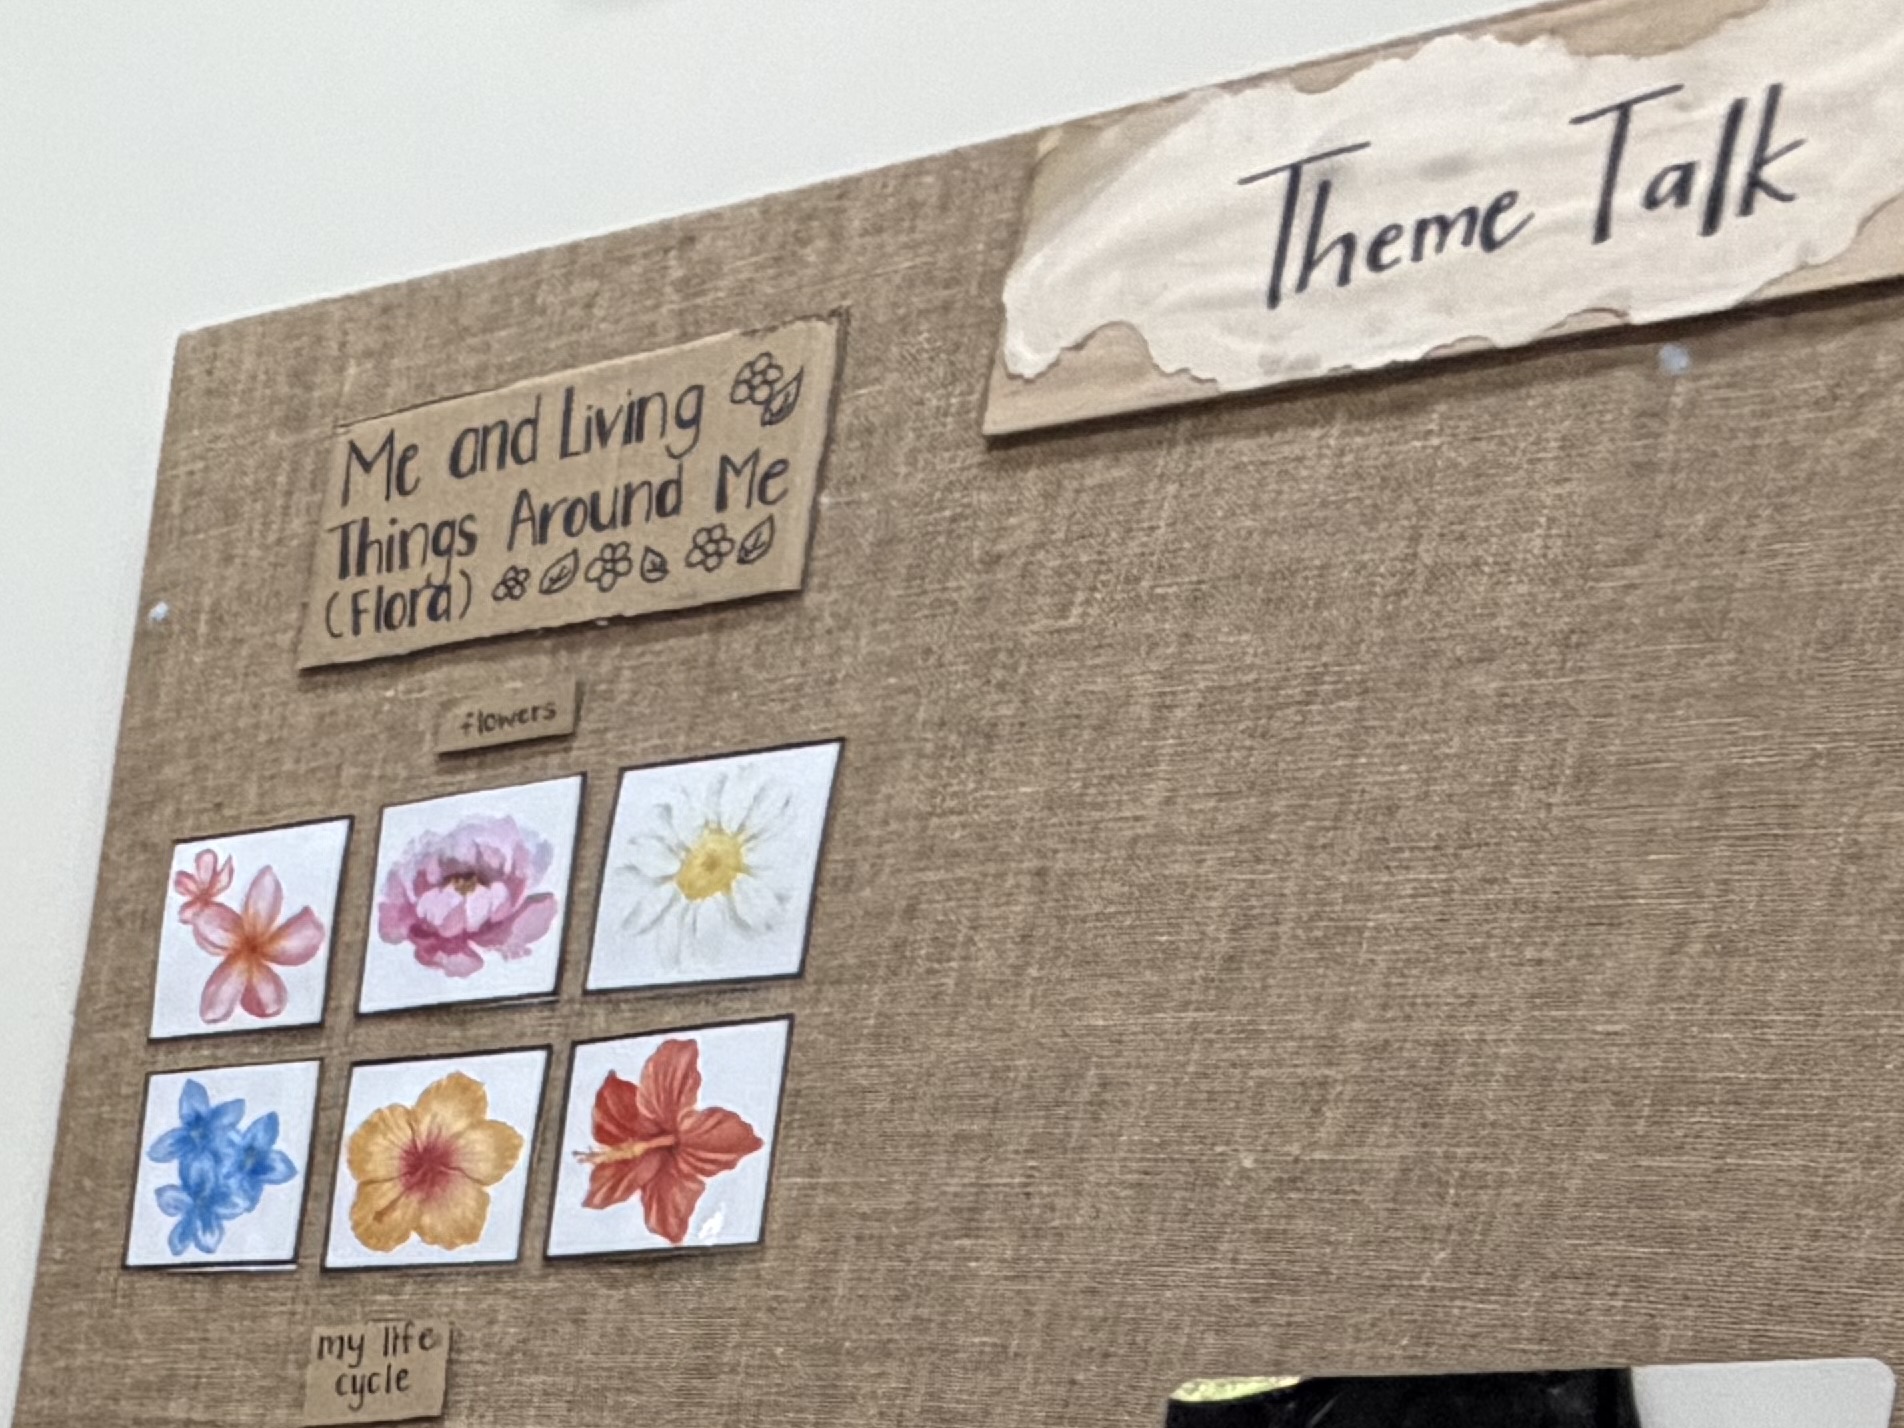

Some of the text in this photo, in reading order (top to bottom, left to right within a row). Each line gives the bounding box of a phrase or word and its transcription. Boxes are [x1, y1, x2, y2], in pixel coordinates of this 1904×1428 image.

[1239, 84, 1807, 309] Theme Talk
[340, 383, 705, 508] Me and Living
[328, 447, 790, 584] Things Around Me
[325, 569, 474, 639] (Flora)
[460, 702, 558, 737] flowers
[317, 1320, 436, 1369] my life
[335, 1364, 410, 1411] cycle
